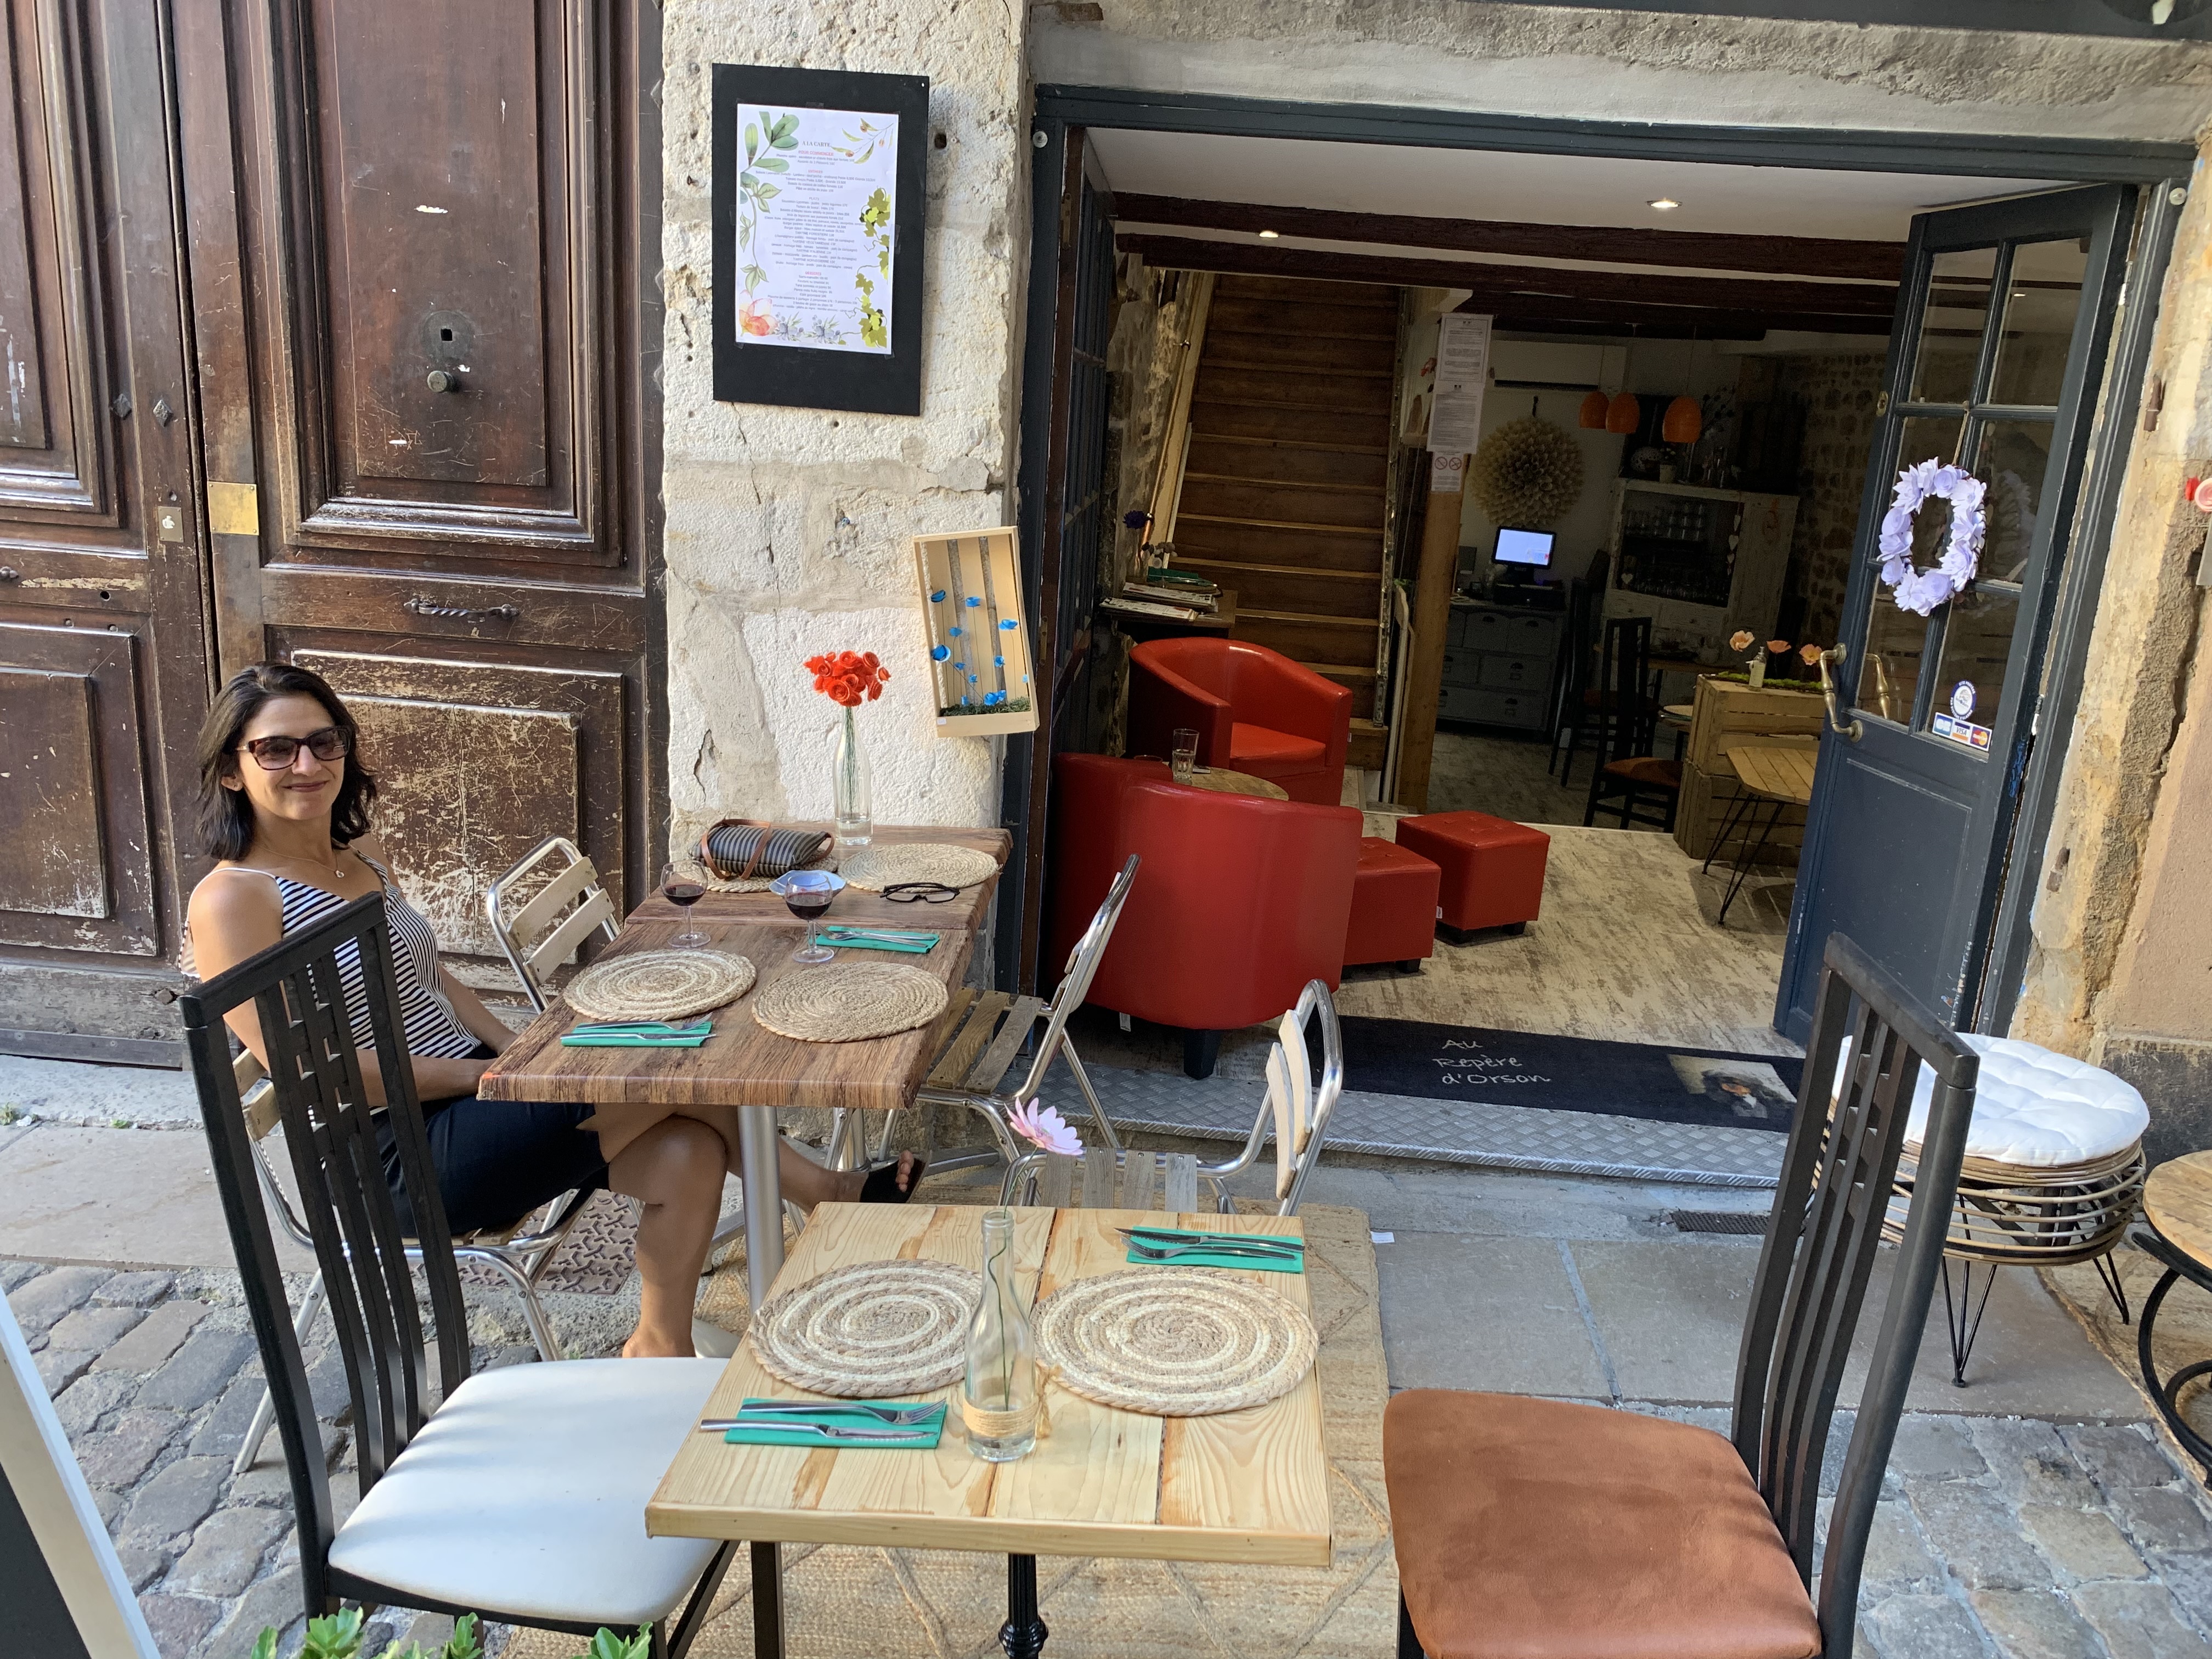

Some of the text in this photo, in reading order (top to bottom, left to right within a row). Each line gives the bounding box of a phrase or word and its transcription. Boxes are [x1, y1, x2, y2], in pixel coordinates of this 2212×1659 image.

[1956, 726, 1967, 736] VISA
[1442, 1040, 1483, 1049] Au
[1432, 1054, 1523, 1071] Repère
[1442, 1073, 1551, 1085] d'Orson
